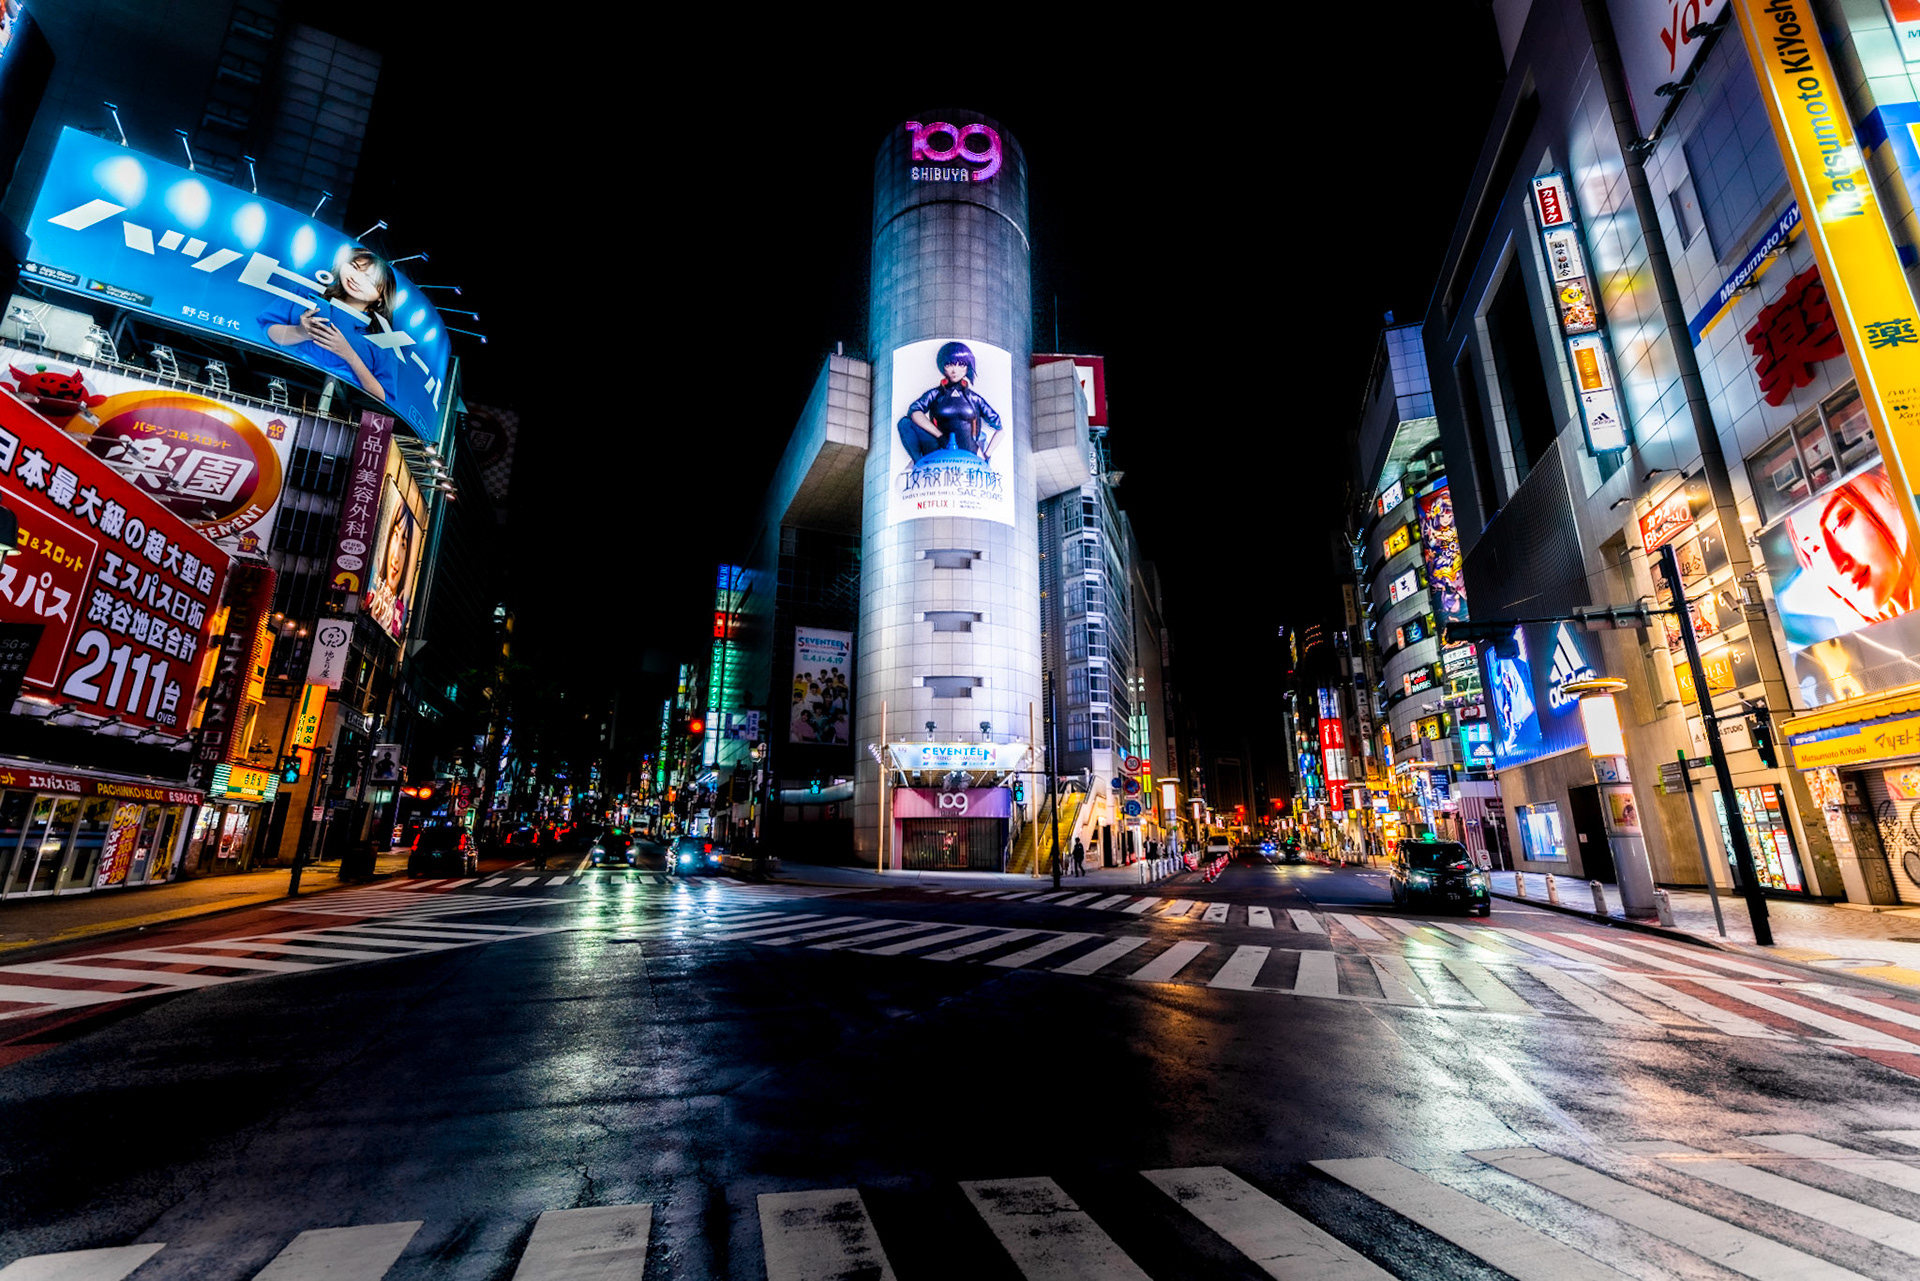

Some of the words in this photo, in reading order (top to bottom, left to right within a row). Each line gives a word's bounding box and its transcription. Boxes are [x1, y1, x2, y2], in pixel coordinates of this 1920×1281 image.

[906, 121, 1003, 181] 109
[911, 167, 969, 182] SHIBUYA
[1542, 189, 1559, 223] カラオケ
[40, 265, 55, 275] App
[1720, 231, 1779, 303] Matsumoto
[107, 285, 130, 298] Google
[130, 291, 145, 301] Play
[182, 305, 241, 331] 野呂佳代
[1744, 264, 1847, 407] 薬
[1864, 318, 1919, 350] 薬
[133, 421, 232, 449] パチンコ&スロット
[268, 423, 284, 434] 40
[105, 434, 254, 503] 楽園
[900, 465, 1003, 493] 攻殻機動隊
[345, 435, 383, 539] 品川美容外科
[917, 499, 948, 510] NETFLIX
[97, 551, 206, 631] エスパス日拓
[87, 589, 198, 663] 渋谷地区合計
[798, 636, 849, 651] SEVENTEEN
[199, 632, 245, 761] エスパス日拓
[157, 711, 177, 726] OVER
[1723, 724, 1744, 735] STUDIO
[922, 747, 997, 761] SEVENTEEN
[1128, 759, 1137, 767] 30
[1801, 751, 1839, 763] Matsumoto
[1839, 744, 1867, 757] KiYoshi
[29, 775, 81, 793] エスパス日拓
[169, 791, 199, 805] ESPACE
[937, 792, 968, 815] 109
[1129, 804, 1135, 814] P
